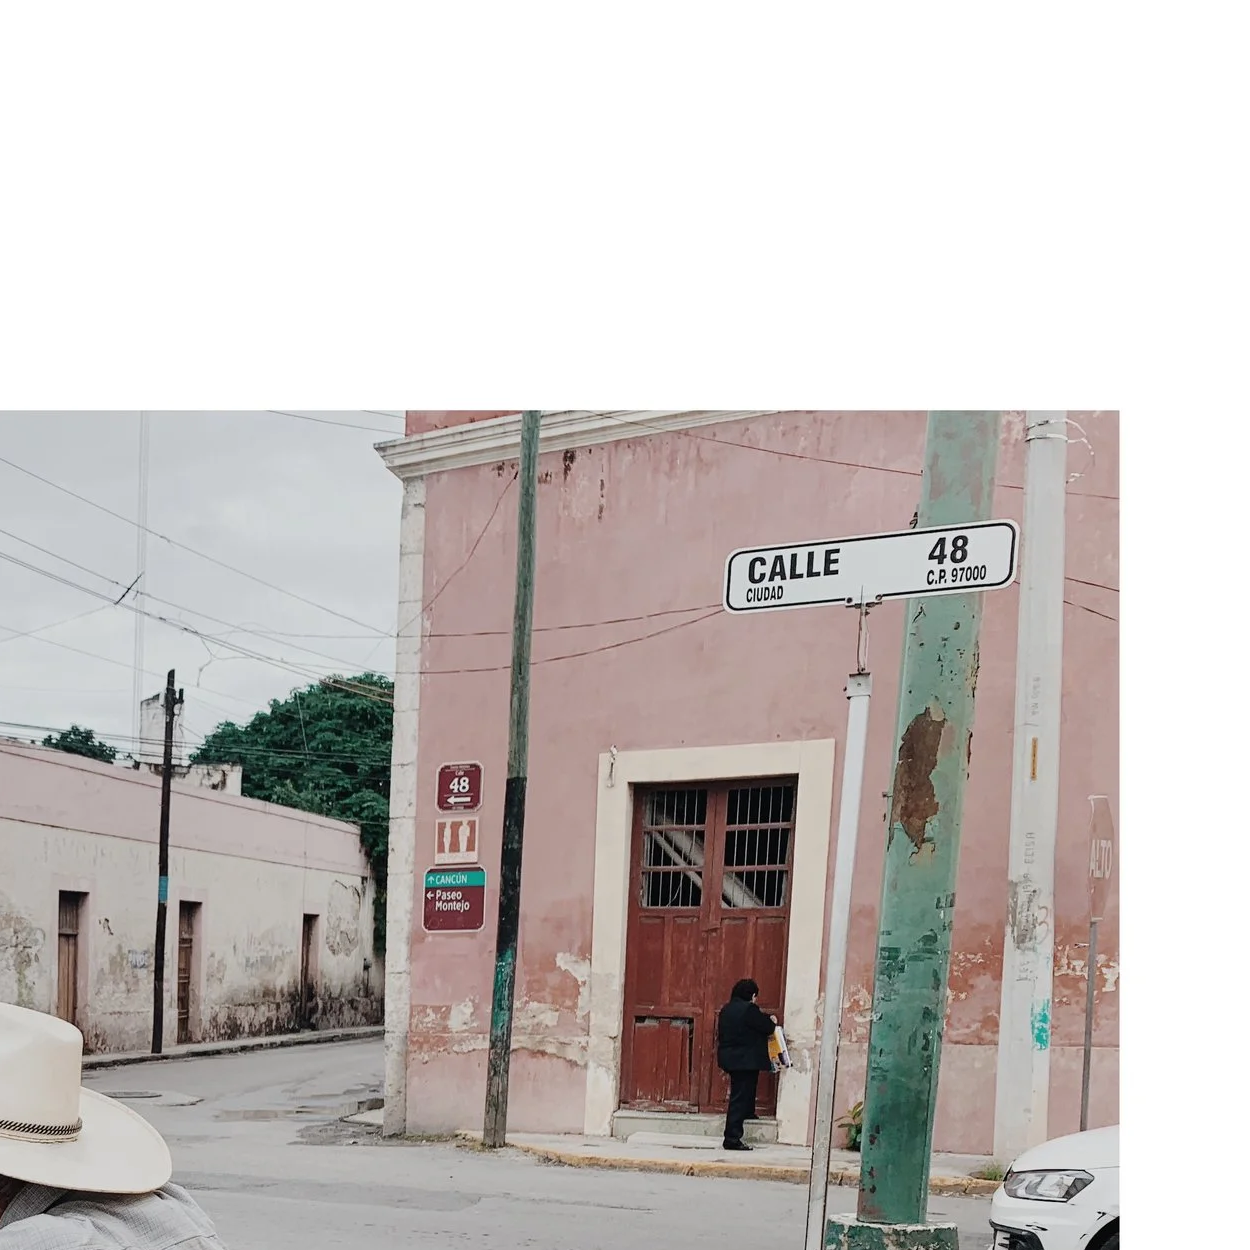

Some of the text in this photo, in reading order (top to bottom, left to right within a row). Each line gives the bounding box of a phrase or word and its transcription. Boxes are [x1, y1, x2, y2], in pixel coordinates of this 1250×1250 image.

[747, 534, 969, 584] CALLE 48
[746, 564, 988, 603] CIUDAD C.P. 97000
[449, 777, 470, 793] 48
[1089, 839, 1112, 880] ALTO
[435, 872, 468, 885] CANCÚN
[435, 889, 463, 901] Paseo
[435, 899, 471, 913] Montejo
